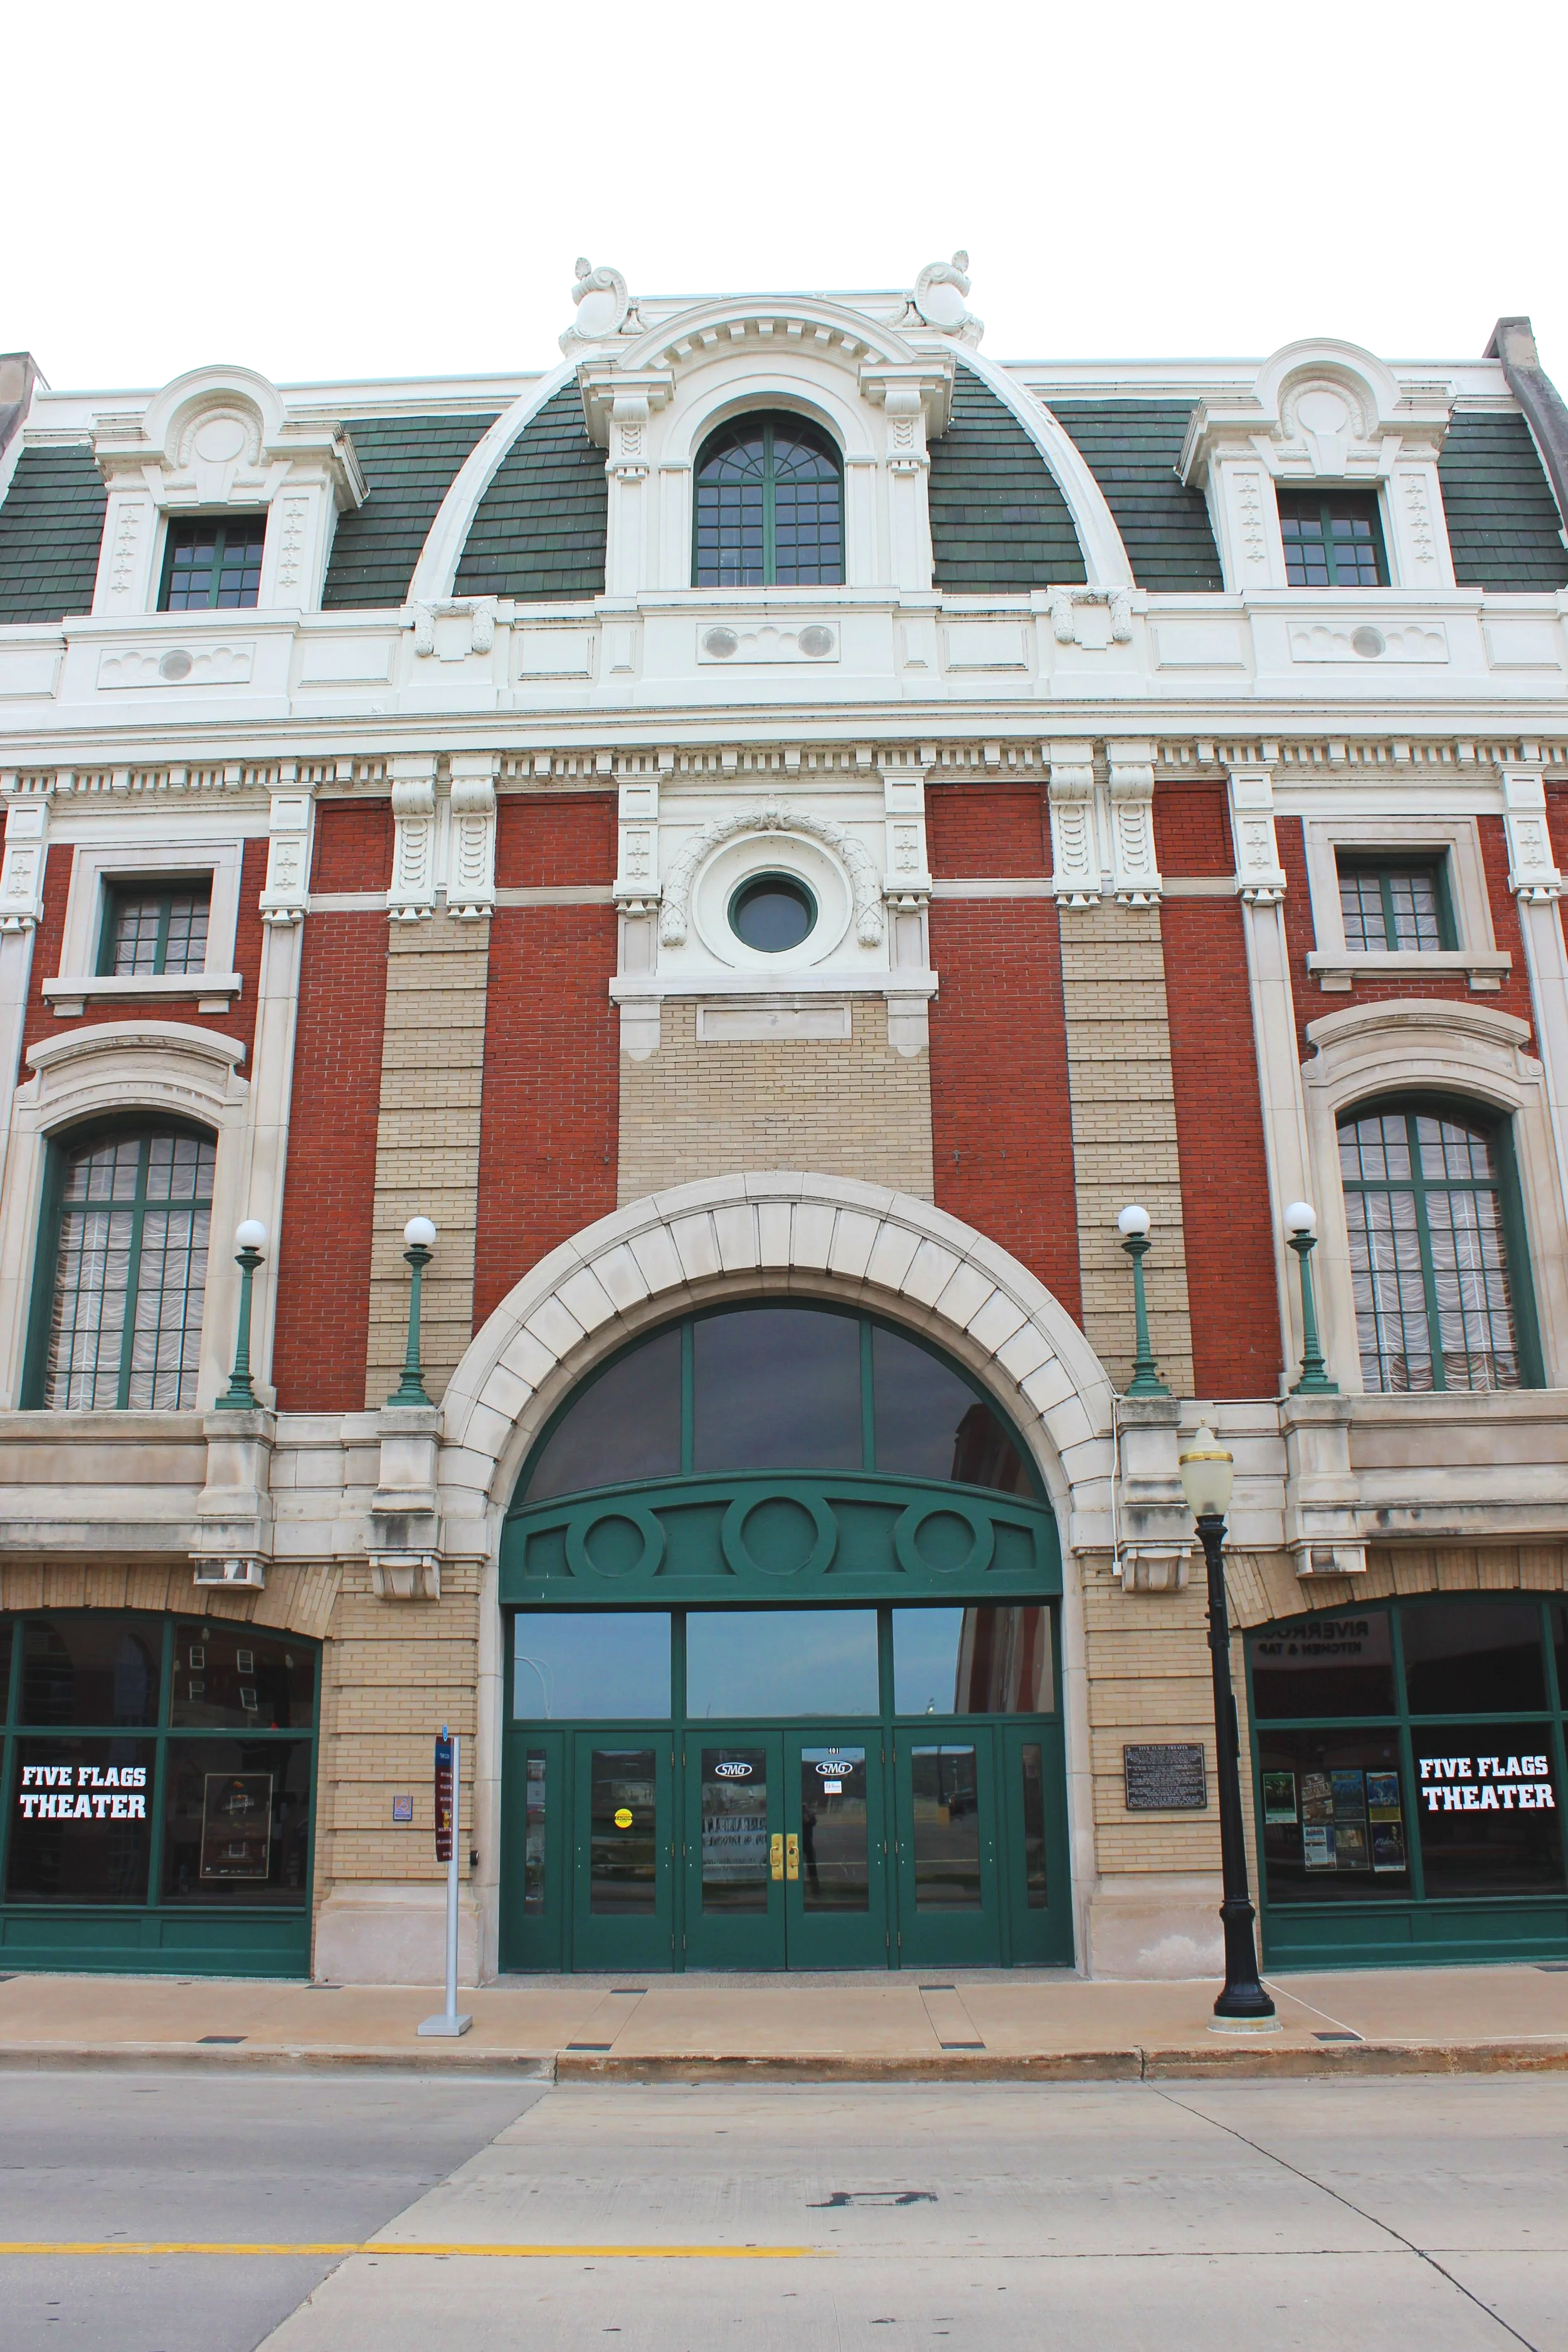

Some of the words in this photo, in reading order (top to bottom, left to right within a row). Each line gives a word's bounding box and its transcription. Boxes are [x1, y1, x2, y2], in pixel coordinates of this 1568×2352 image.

[22, 1766, 72, 1785] FIVE
[78, 1767, 146, 1787] FLAGS
[722, 1765, 745, 1775] SMG
[822, 1764, 845, 1774] SMG
[1419, 1758, 1472, 1778] FIVE
[1477, 1756, 1548, 1777] FLAGS
[19, 1794, 146, 1818] THEATER
[1422, 1784, 1555, 1811] THEATER
